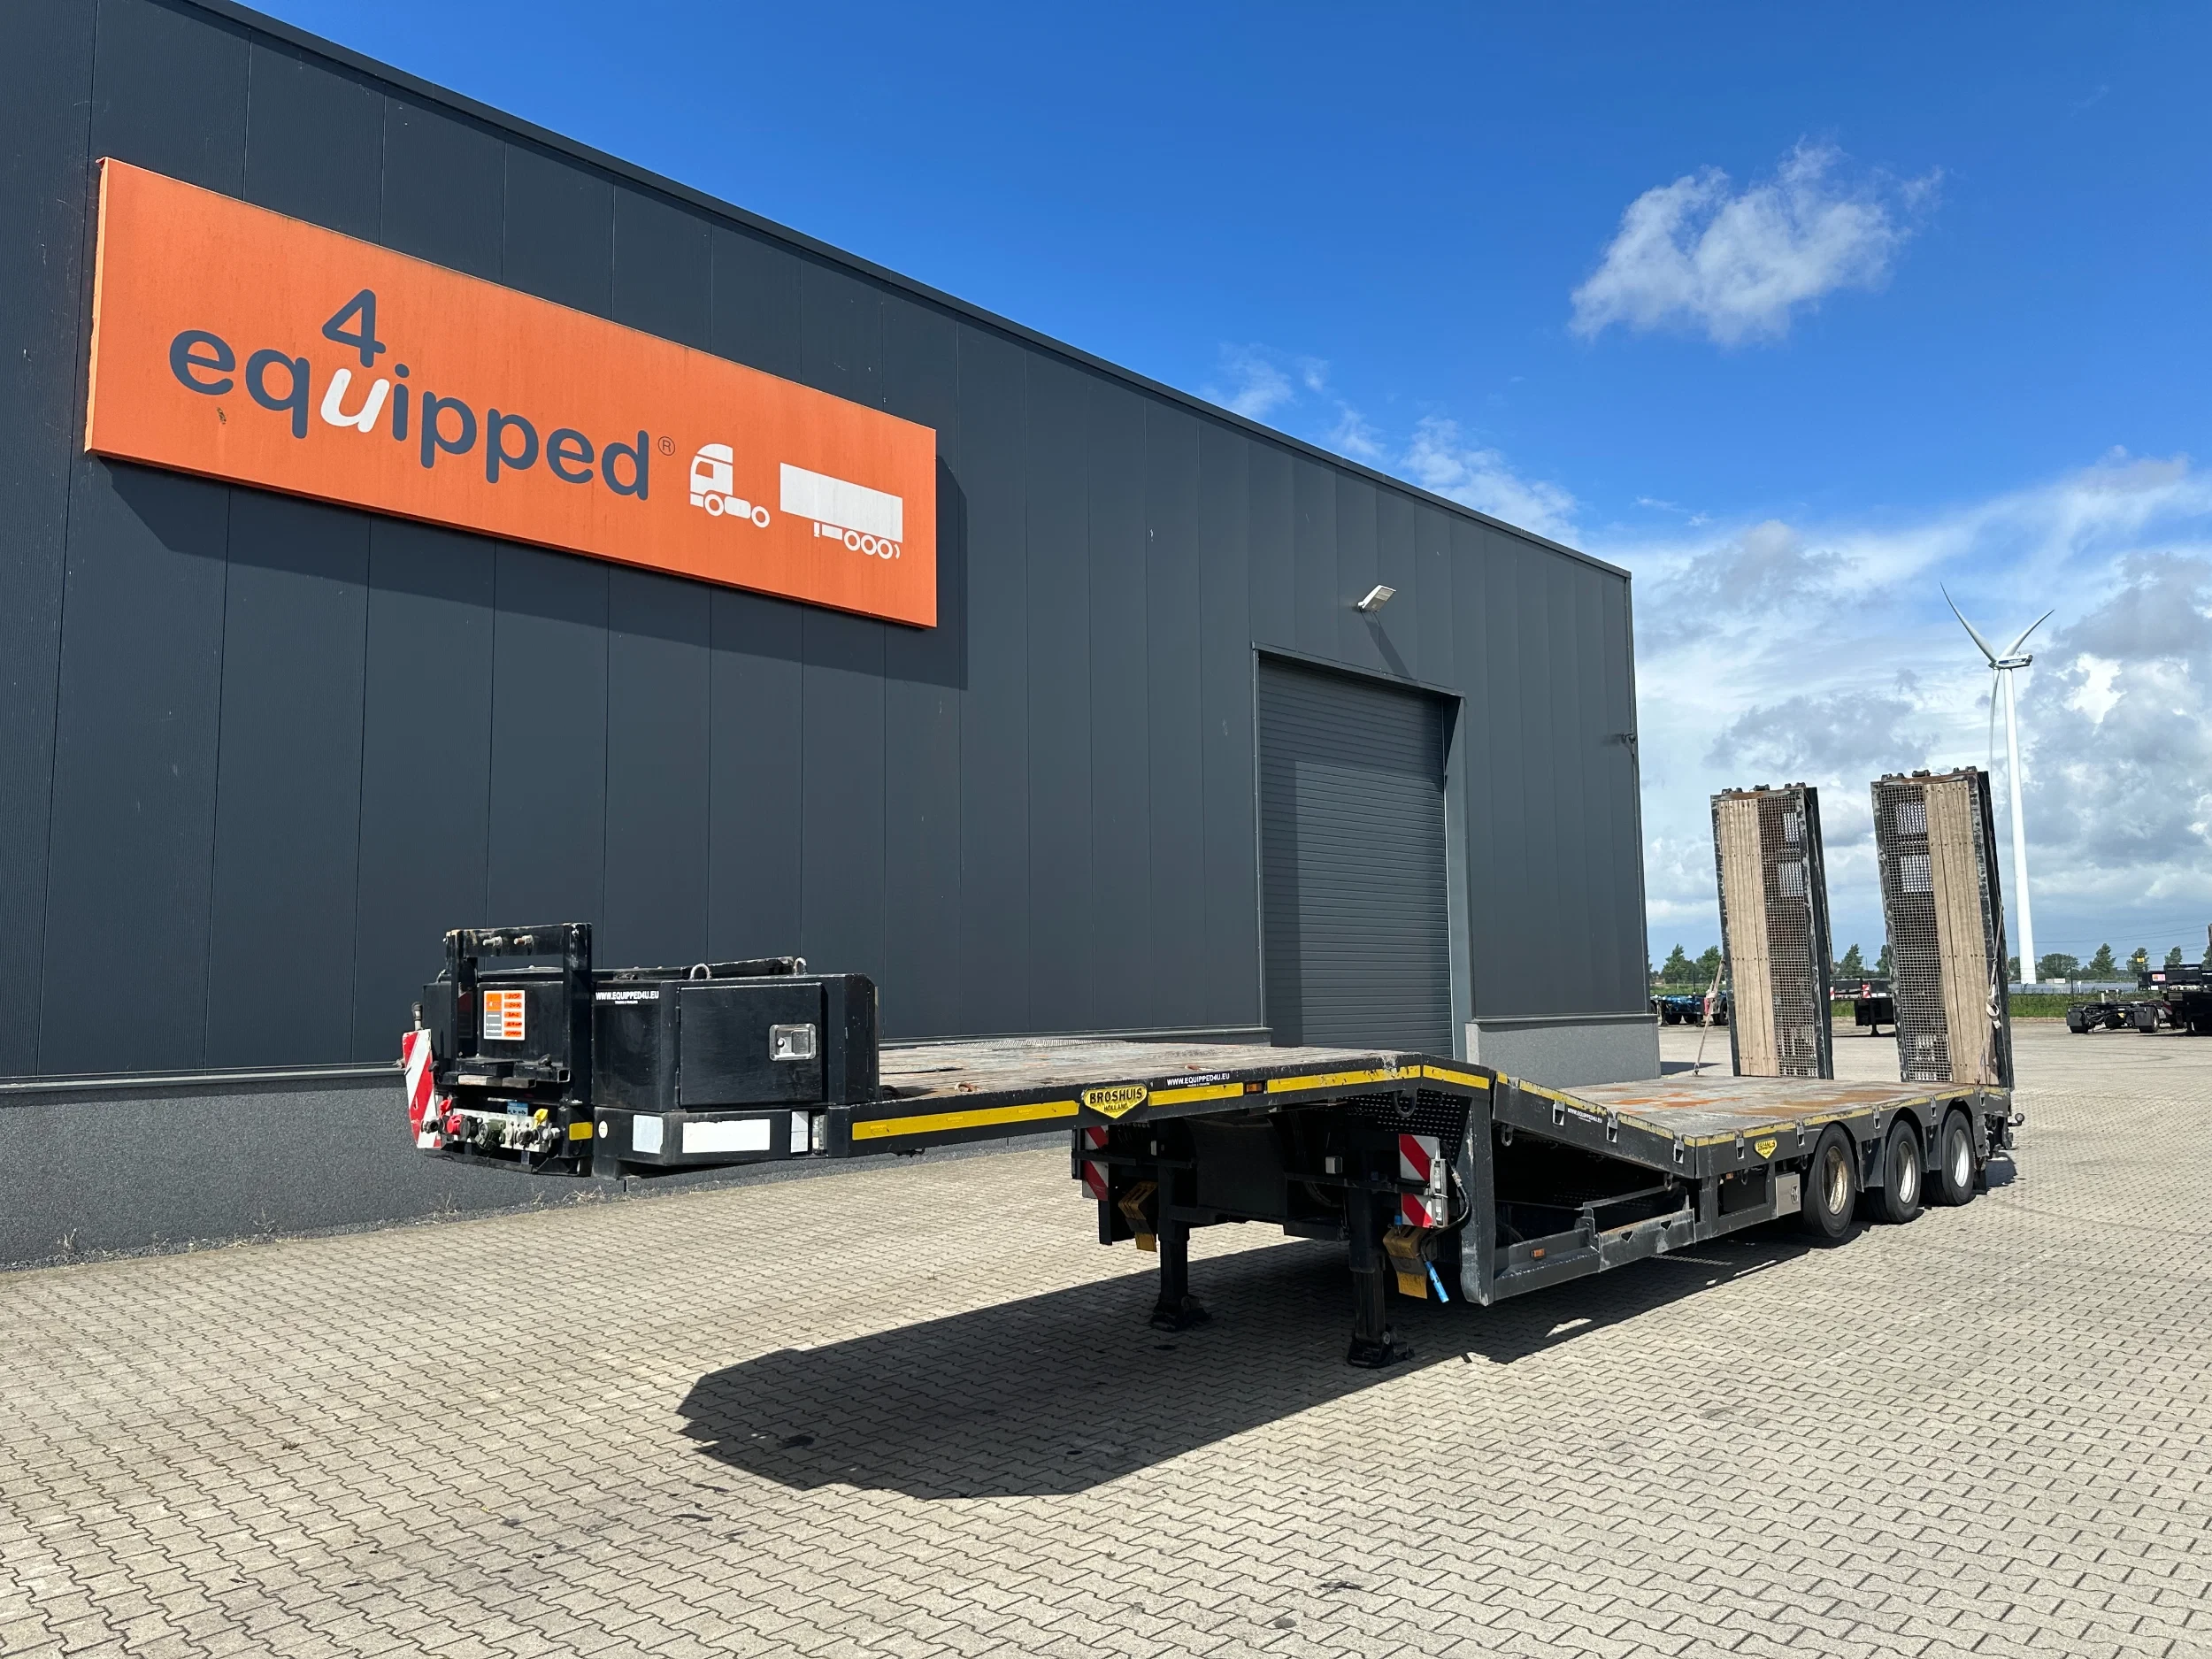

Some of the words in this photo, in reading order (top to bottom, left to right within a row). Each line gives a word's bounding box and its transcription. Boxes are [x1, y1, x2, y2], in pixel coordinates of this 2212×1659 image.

[321, 288, 387, 368] 4
[169, 329, 649, 501] equipped
[595, 990, 660, 1001] WWW.EQUIPPED4U.EU
[1166, 1072, 1231, 1087] WWW.EQUIPPED4U.EU
[1089, 1087, 1143, 1104] BROSHUIS
